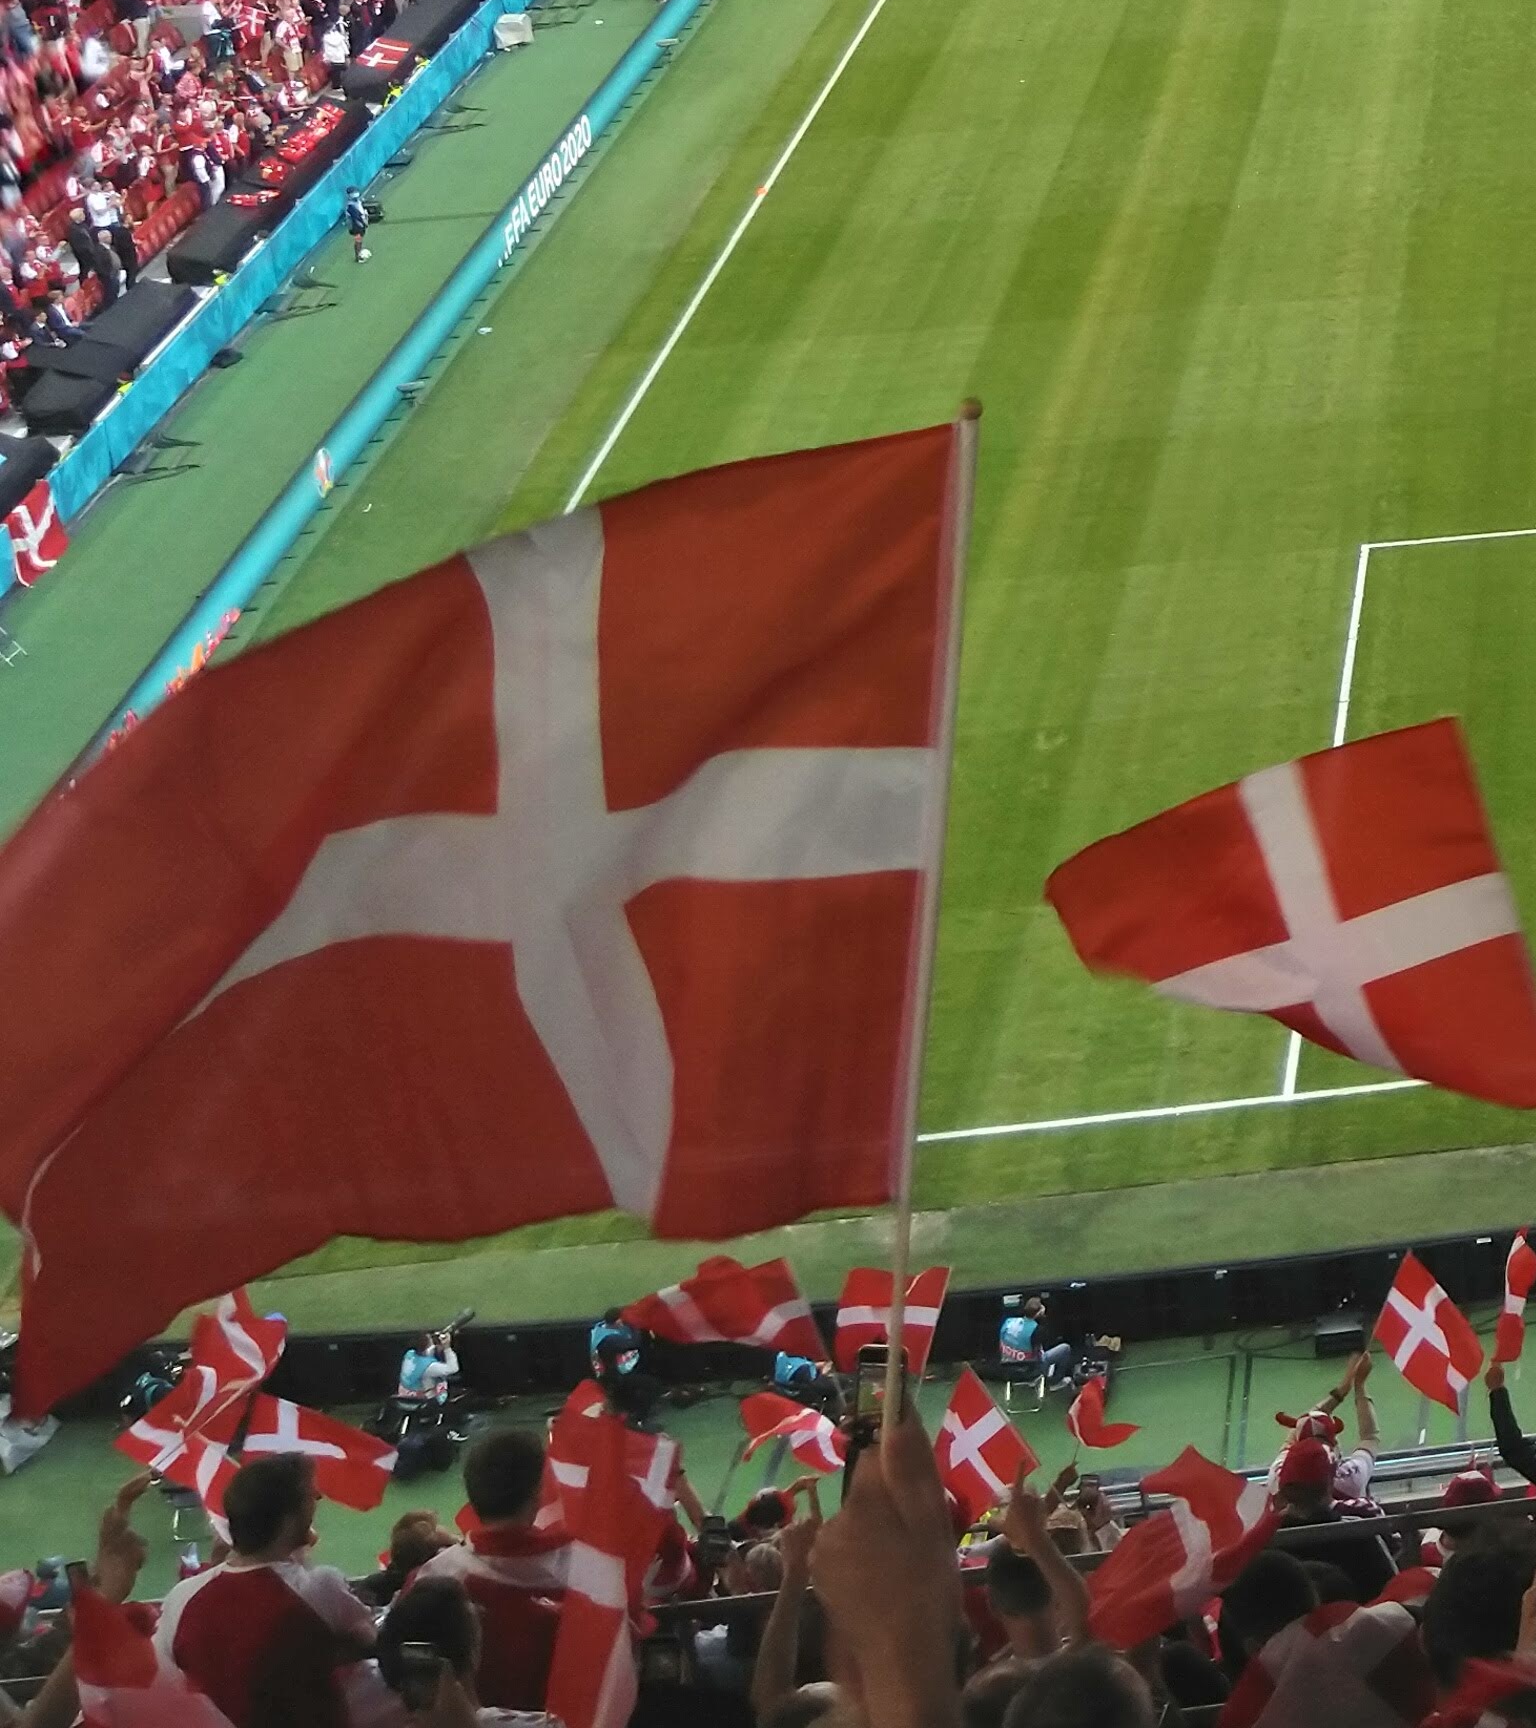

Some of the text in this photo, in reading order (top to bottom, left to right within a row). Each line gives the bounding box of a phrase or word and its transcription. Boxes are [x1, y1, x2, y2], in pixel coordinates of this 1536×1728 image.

[498, 114, 592, 267] EFA EURO 2020
